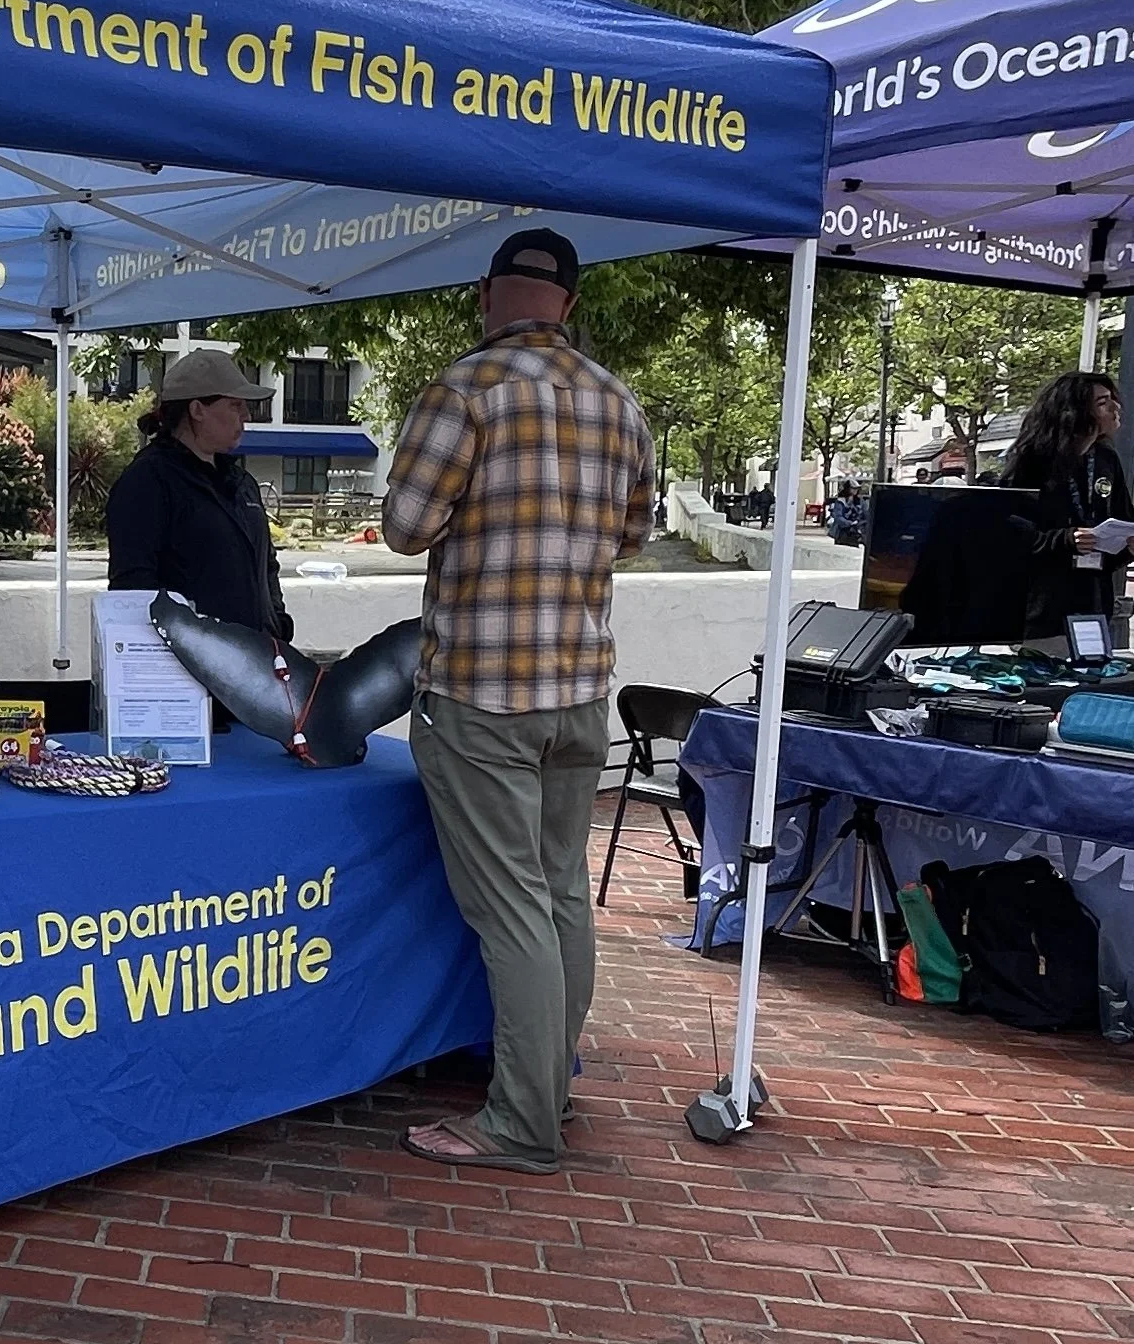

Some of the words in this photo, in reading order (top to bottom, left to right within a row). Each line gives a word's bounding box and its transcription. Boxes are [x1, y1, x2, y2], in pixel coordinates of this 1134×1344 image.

[227, 24, 293, 90] of
[311, 30, 435, 108] Fish
[452, 67, 555, 125] and
[572, 72, 747, 152] Wildlife
[952, 26, 1134, 90] Ocean
[1, 740, 19, 753] 64
[37, 874, 287, 957] Department
[297, 866, 336, 909] of
[117, 925, 333, 1023] Wildlife
